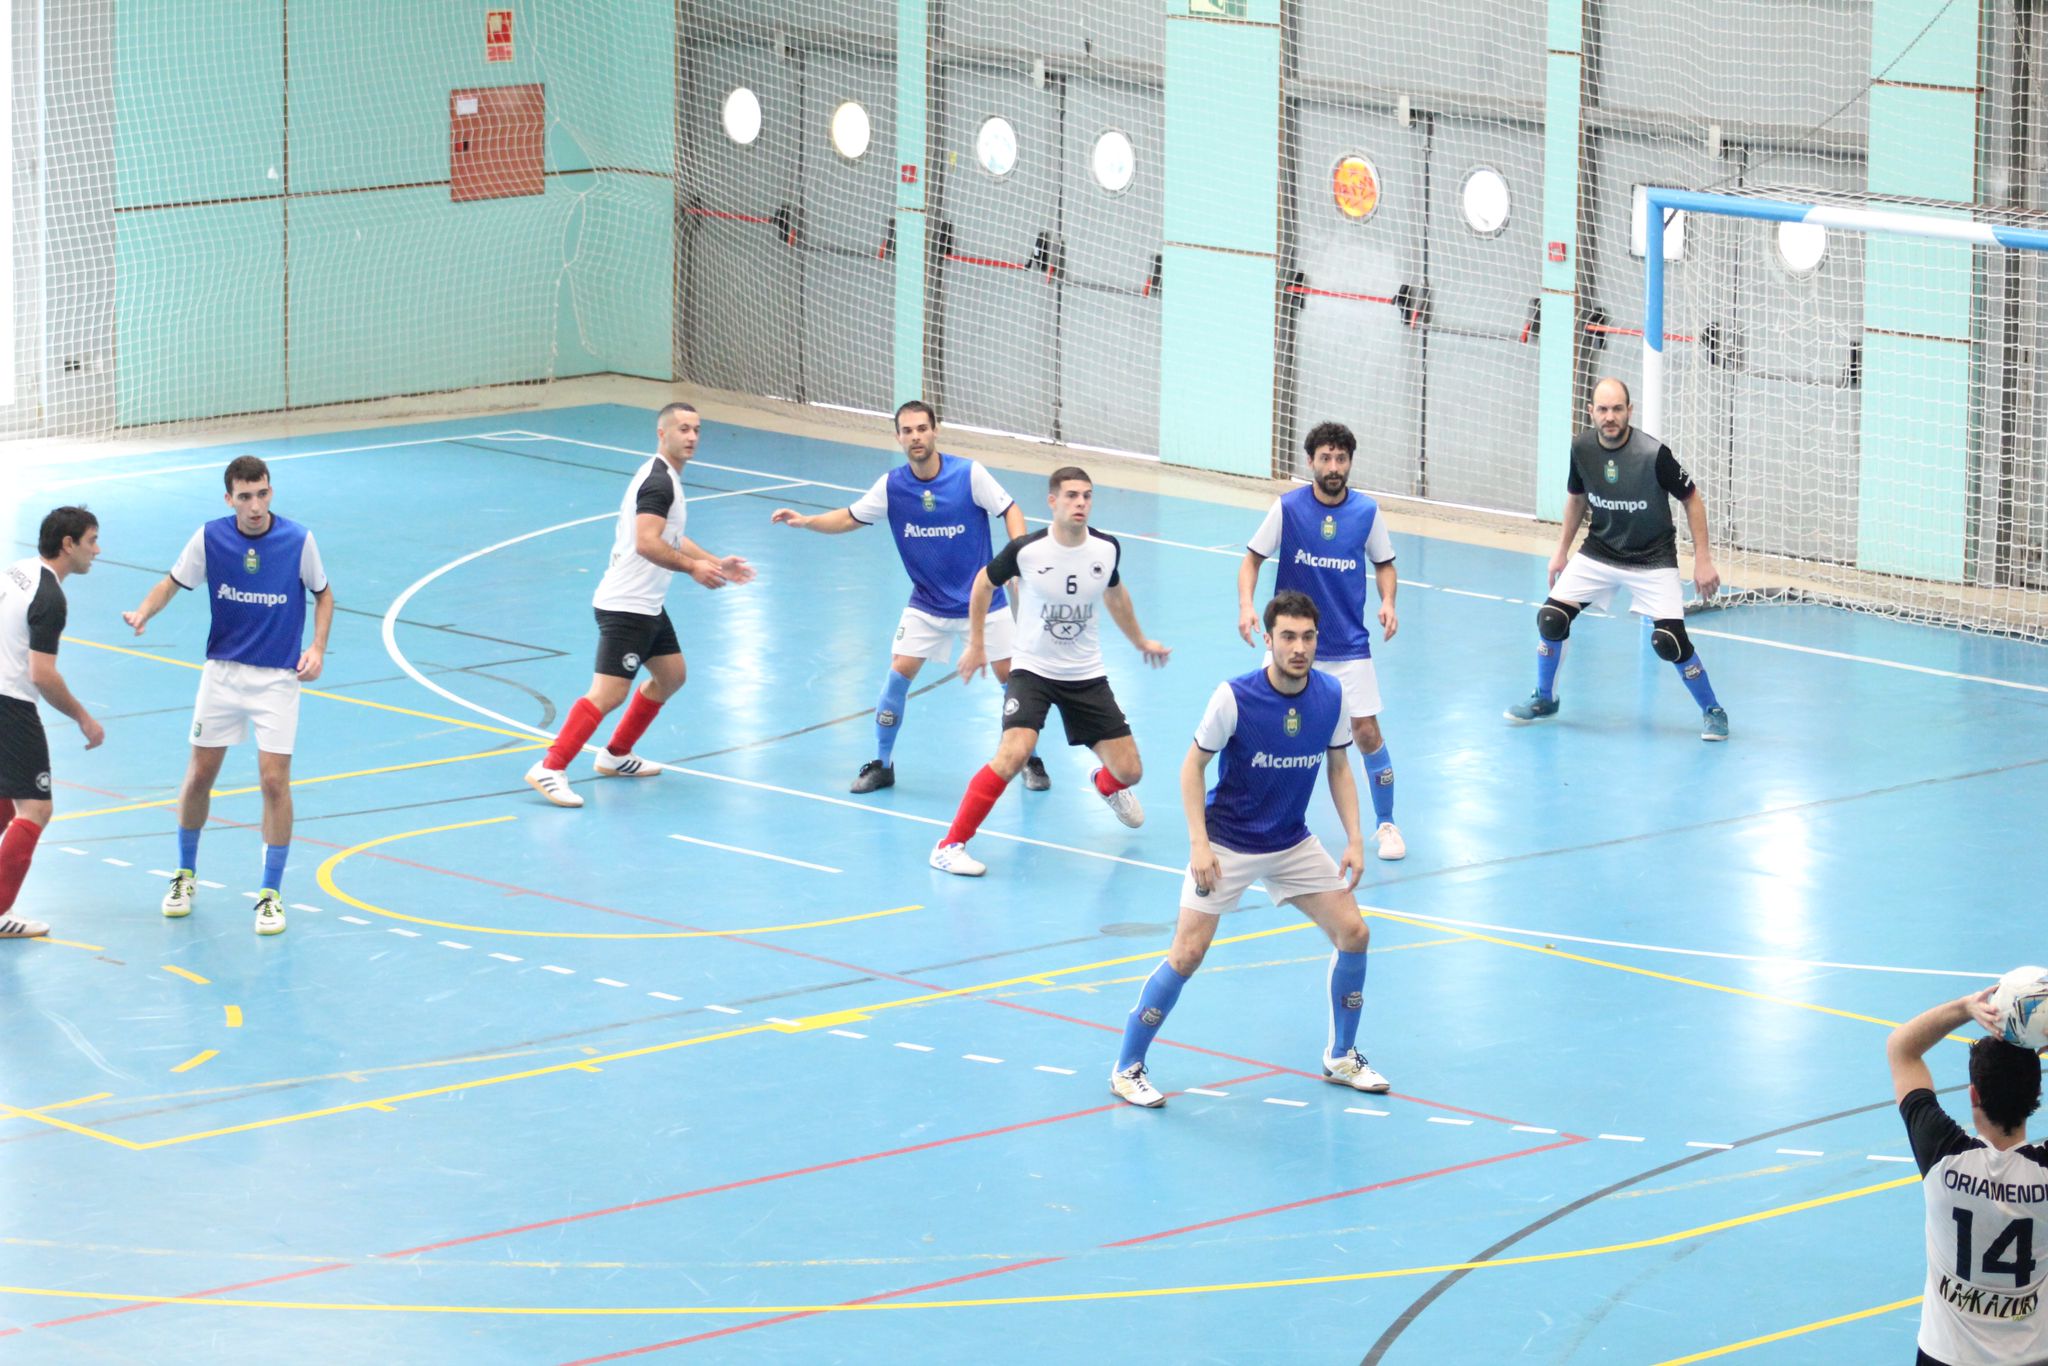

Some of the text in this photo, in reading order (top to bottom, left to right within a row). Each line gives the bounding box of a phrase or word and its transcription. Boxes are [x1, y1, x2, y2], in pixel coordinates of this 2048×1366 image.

[904, 522, 966, 539] Alcampo
[1294, 548, 1357, 572] Alcampo
[217, 583, 288, 607] Alcampo
[1066, 574, 1078, 595] 6
[1251, 751, 1325, 769] Alcampo
[1952, 1206, 2037, 1288] 14
